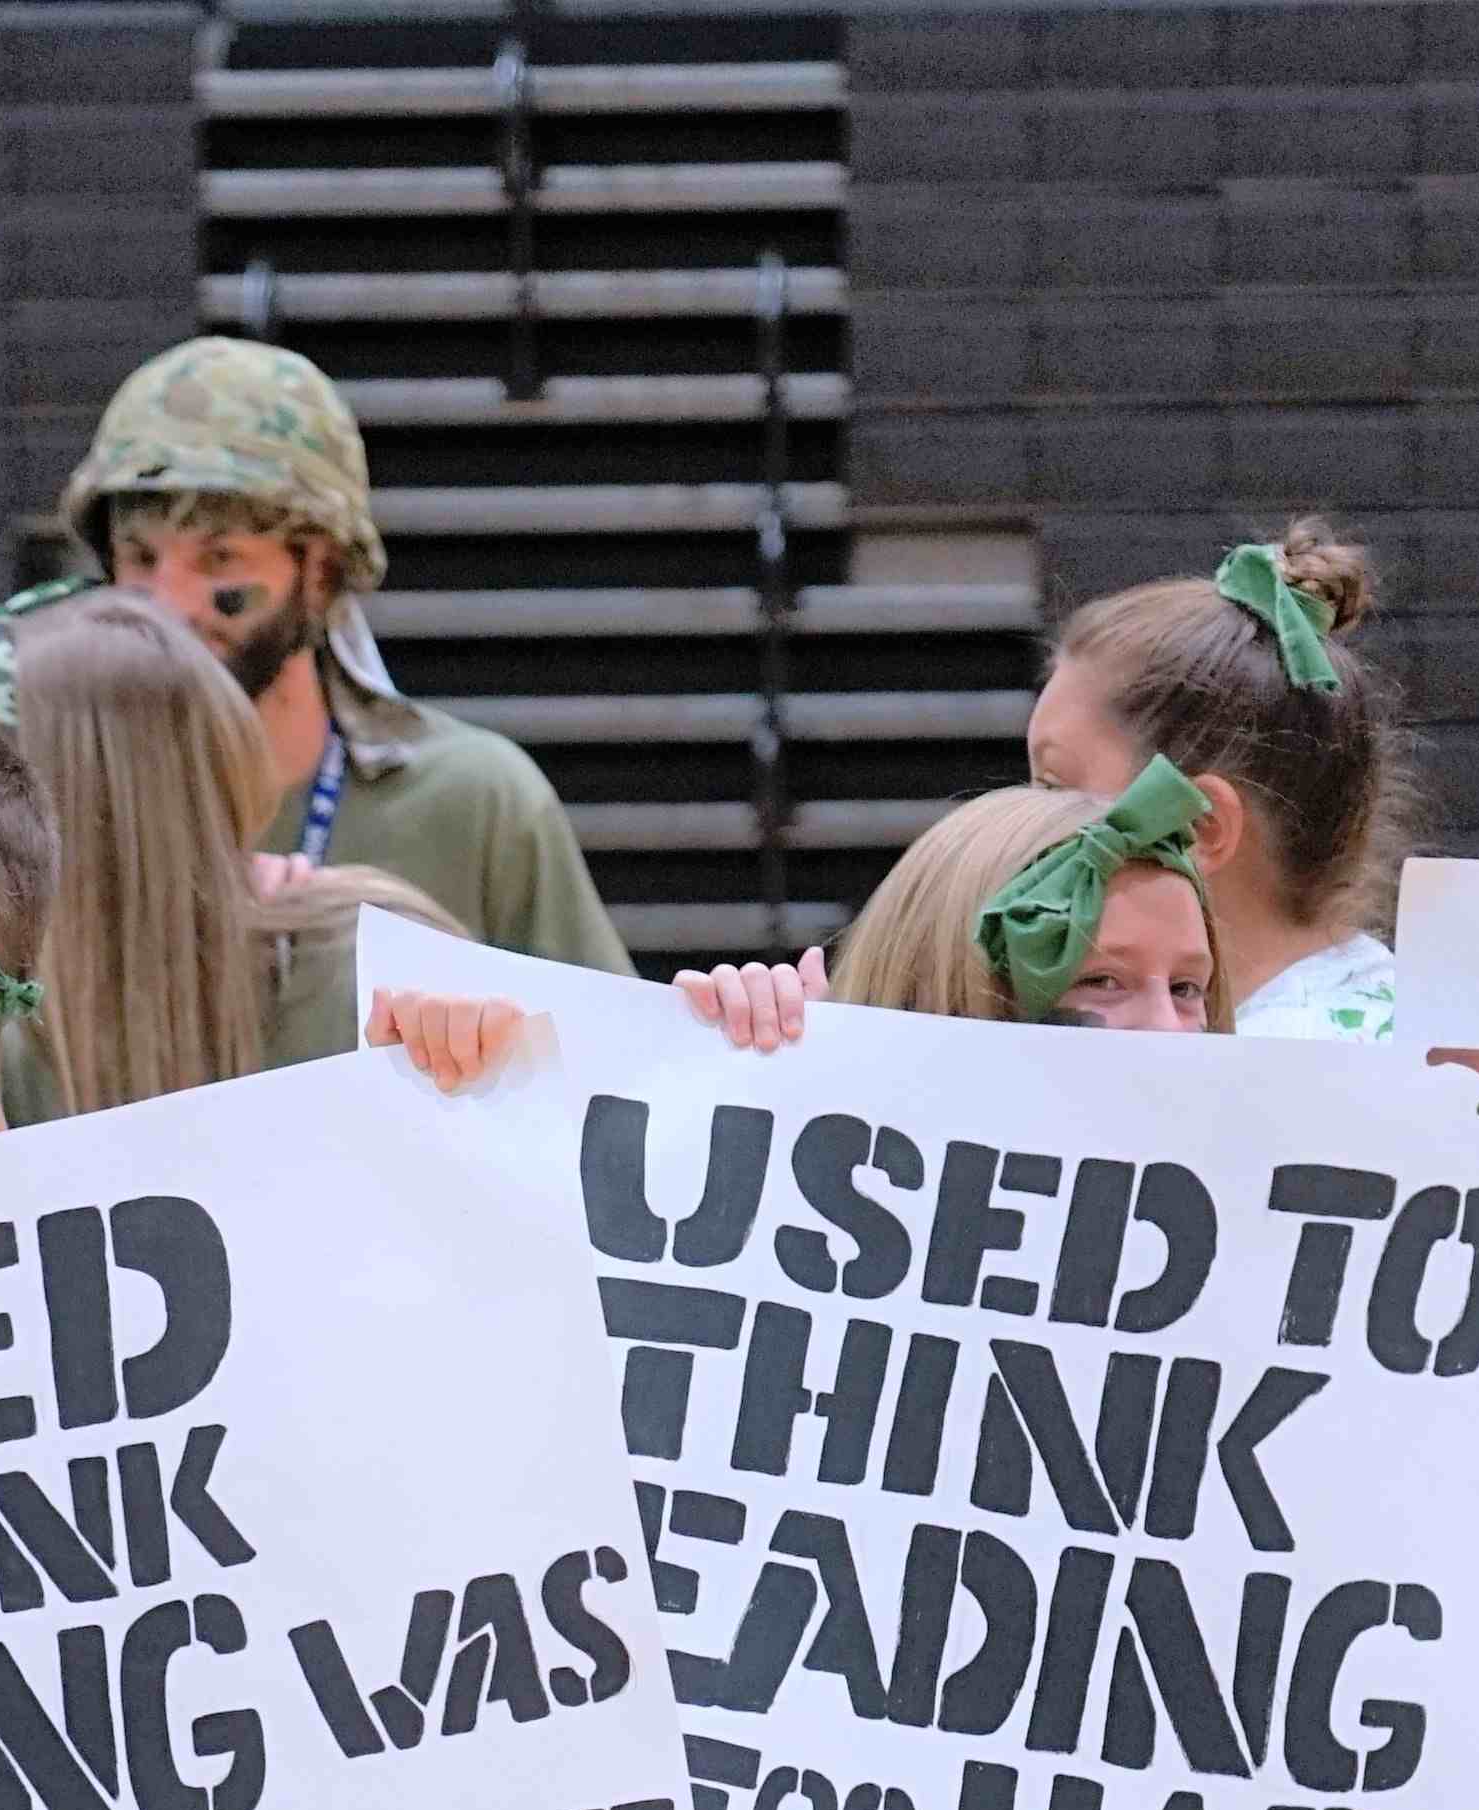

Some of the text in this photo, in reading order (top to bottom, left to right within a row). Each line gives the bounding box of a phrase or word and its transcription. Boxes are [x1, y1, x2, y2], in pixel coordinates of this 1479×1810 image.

[581, 1095, 1217, 1333] USED
[598, 1277, 1330, 1552] THINK
[288, 1546, 630, 1758] WAS
